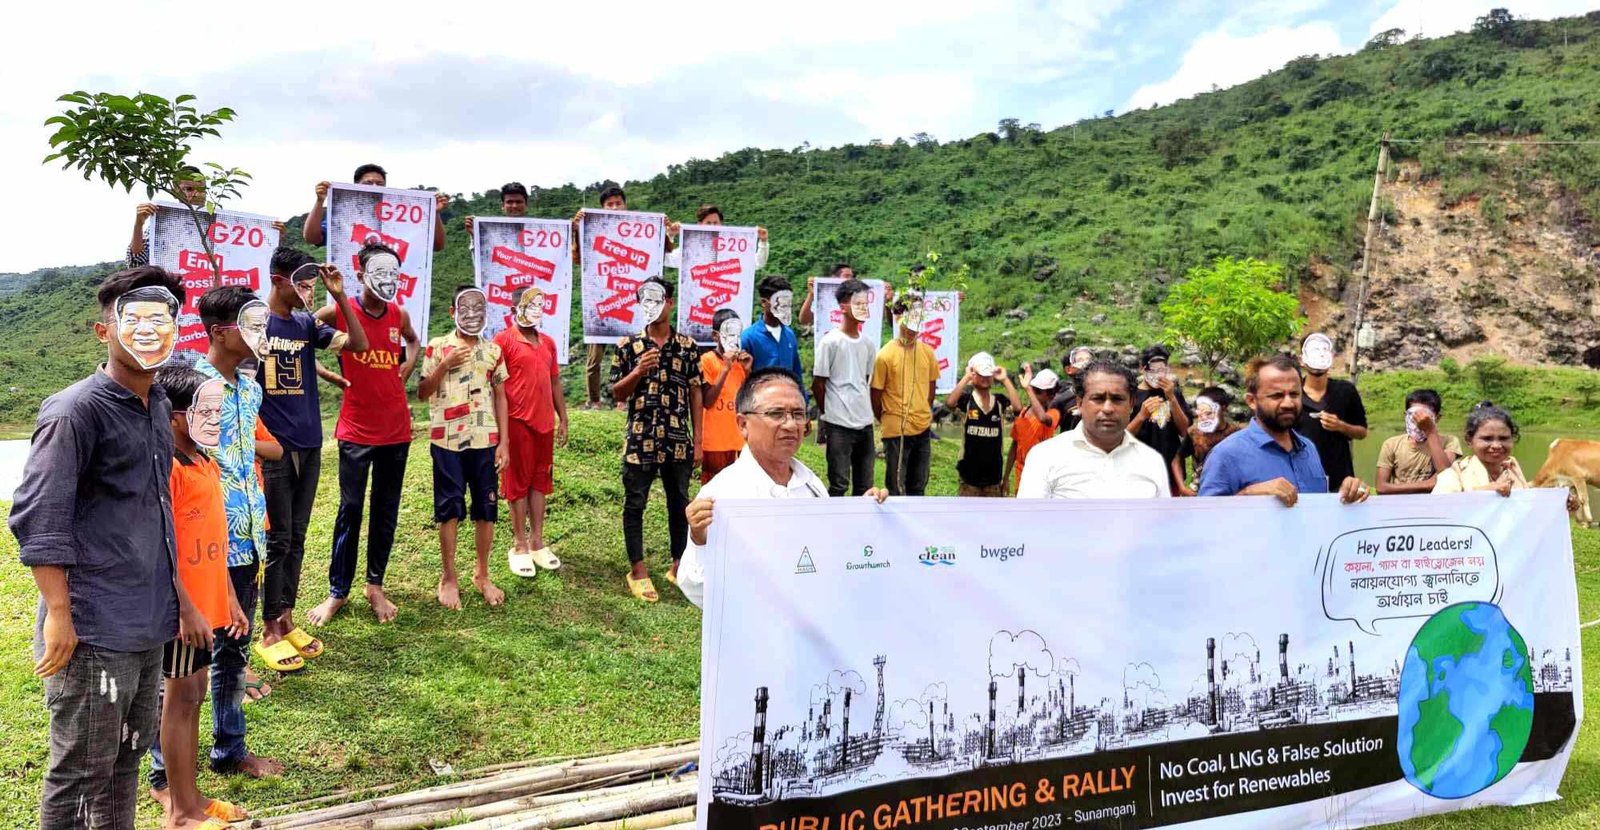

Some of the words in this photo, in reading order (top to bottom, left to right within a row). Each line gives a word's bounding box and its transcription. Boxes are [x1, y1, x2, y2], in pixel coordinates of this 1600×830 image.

[374, 201, 423, 224] G20
[207, 221, 264, 248] G20
[617, 221, 655, 239] G20
[517, 230, 562, 248] G20
[712, 236, 747, 252] G20
[602, 240, 628, 257] Free
[630, 252, 646, 265] up
[601, 263, 630, 275] Debt
[221, 275, 251, 287] Fuel
[511, 275, 533, 285] are
[613, 280, 636, 290] Free
[706, 293, 728, 308] Our
[980, 544, 1025, 561] bwged
[1357, 540, 1380, 557] Hey
[1386, 535, 1414, 552] G20
[1420, 535, 1473, 551] Leaders!
[918, 551, 956, 560] clean
[1402, 558, 1411, 569] বা
[1427, 588, 1449, 605] চাই
[1160, 762, 1183, 780] No
[1187, 753, 1227, 776] Coal,
[1230, 749, 1264, 770] LNG
[1267, 747, 1279, 765] &
[1282, 744, 1320, 763] False
[1324, 736, 1384, 758] Solution
[1160, 786, 1209, 808] Invest
[1213, 780, 1236, 799] for
[1239, 767, 1332, 794] Renewables
[873, 782, 1027, 830] GATHERING
[1034, 777, 1055, 804] &
[1063, 765, 1137, 800] RALLY
[1032, 813, 1062, 829] 2023
[1074, 800, 1137, 823] Sunamganj
